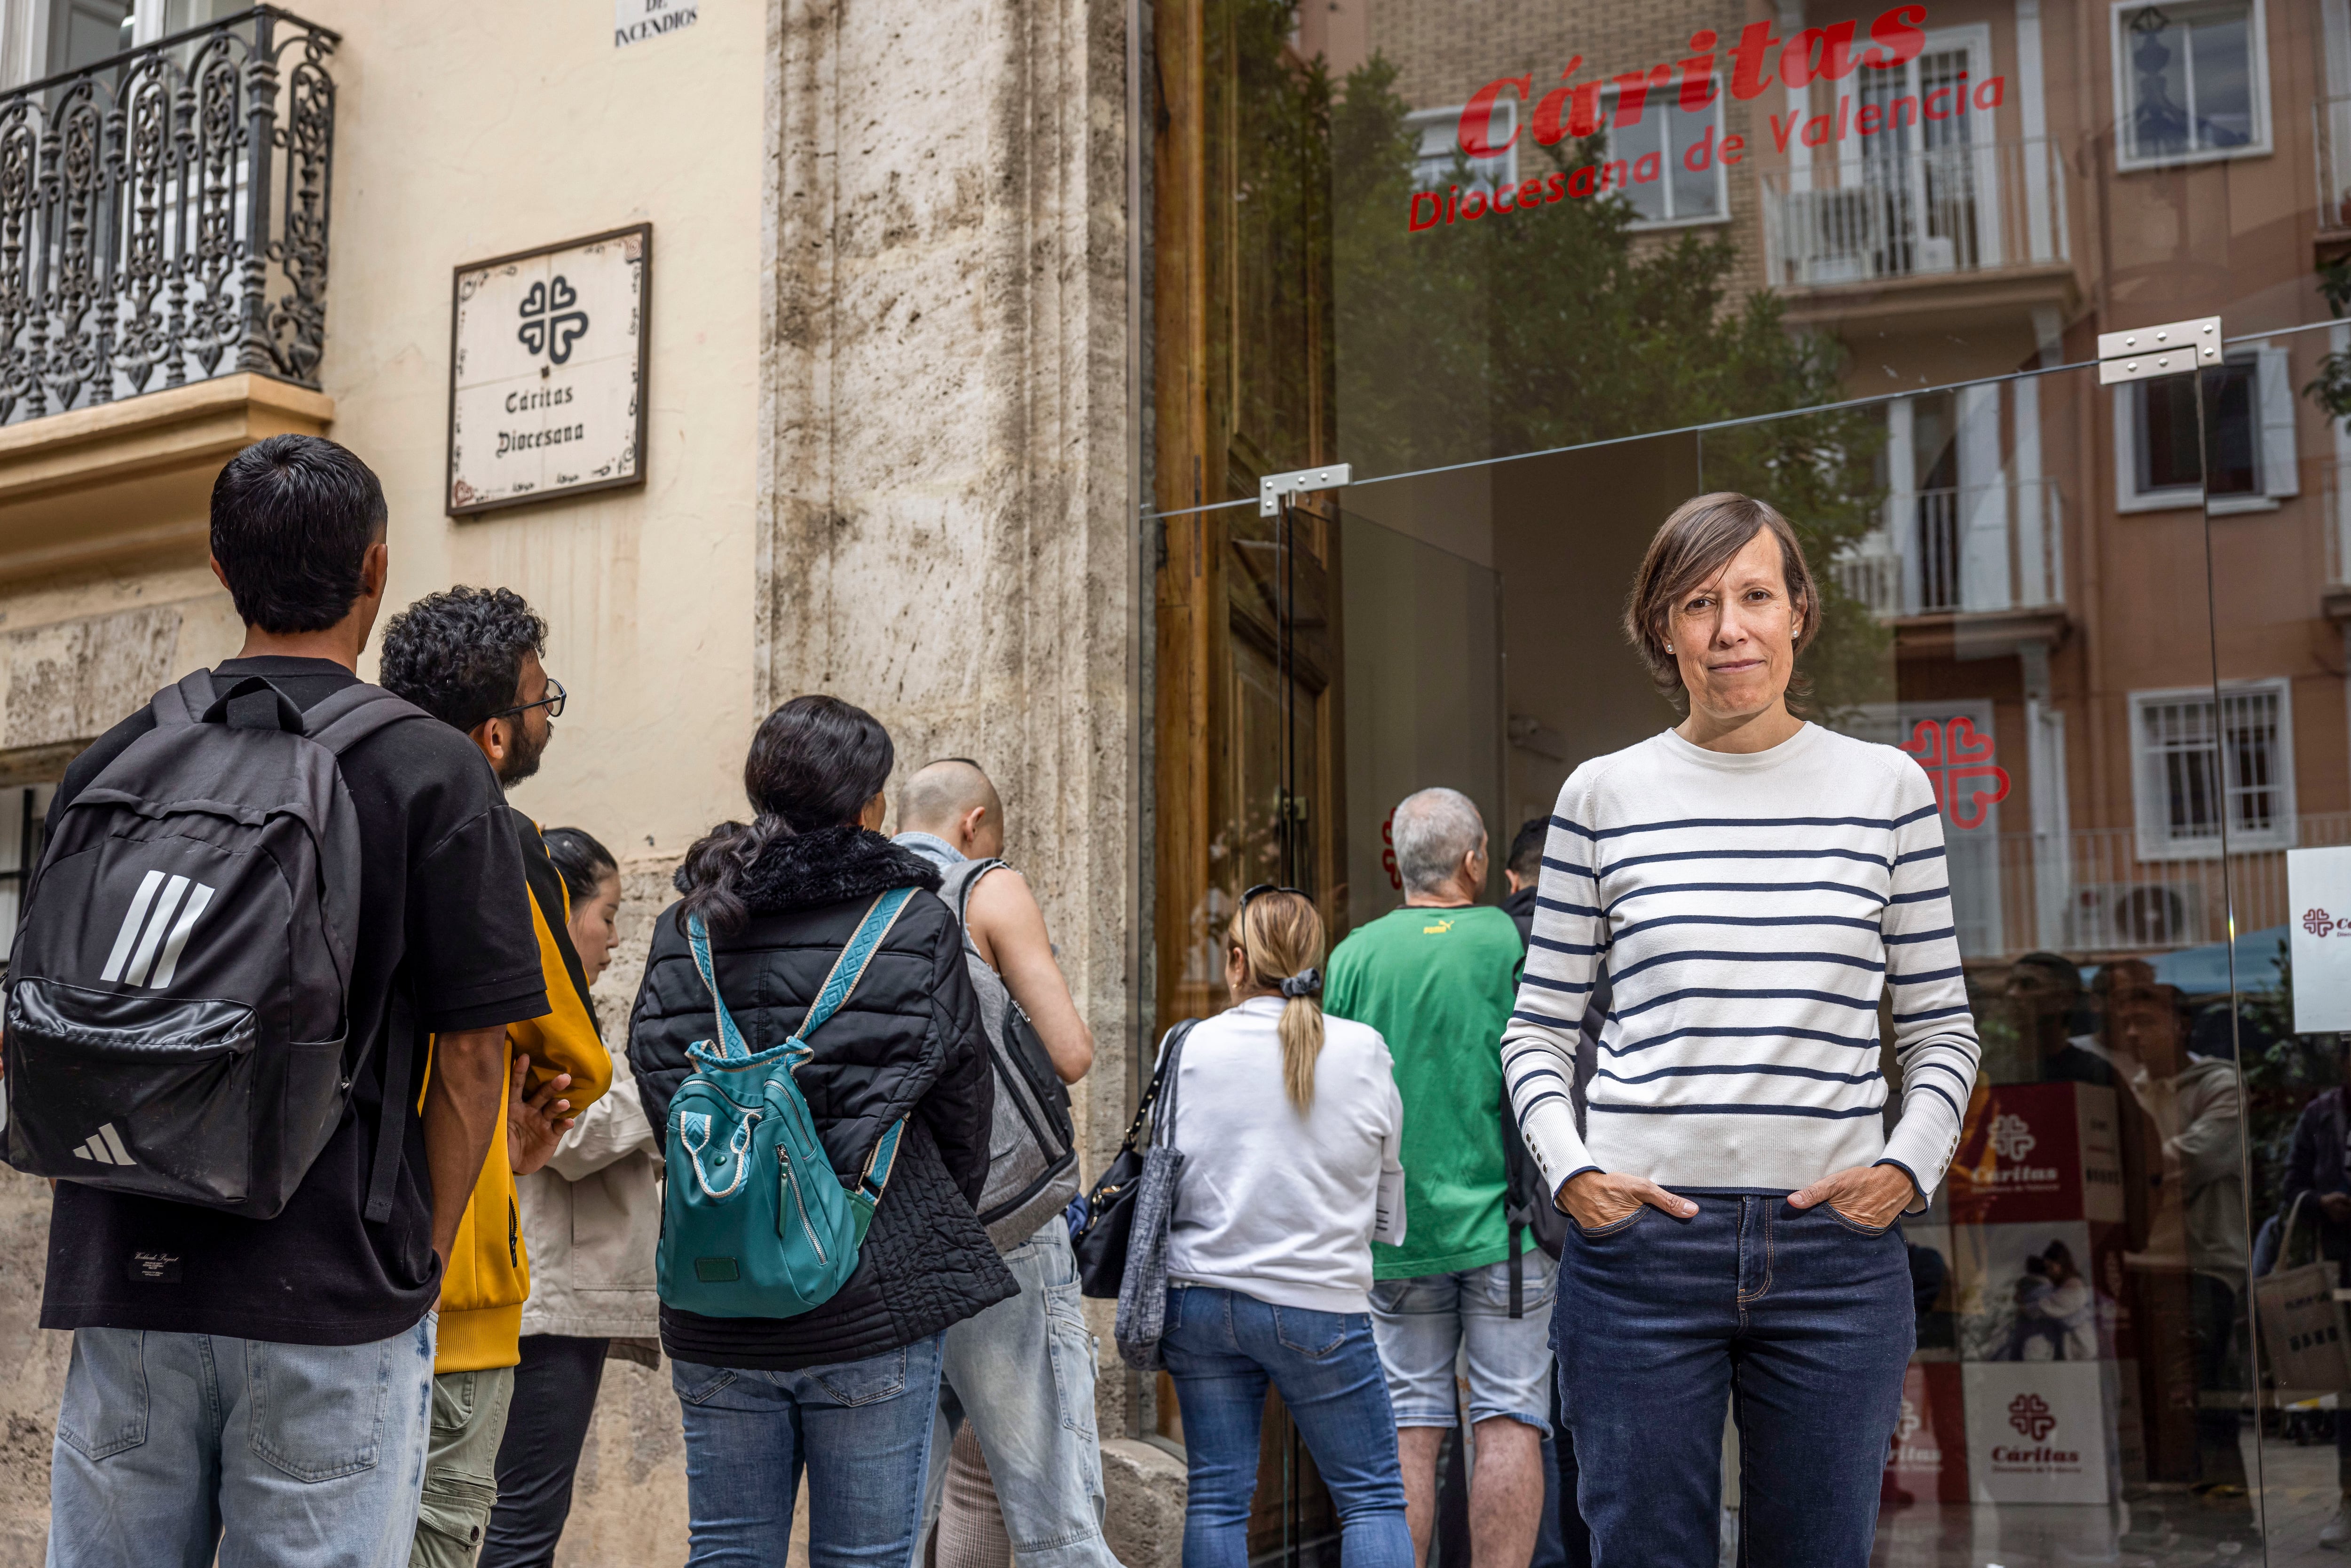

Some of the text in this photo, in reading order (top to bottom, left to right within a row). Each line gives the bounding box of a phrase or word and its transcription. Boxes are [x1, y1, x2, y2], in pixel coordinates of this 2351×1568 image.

[615, 8, 697, 47] INCENDIOS
[1458, 4, 1927, 158] Cáritas
[1409, 71, 2005, 233] Diocesana de Valencia
[505, 386, 573, 414] Cáritas
[496, 423, 584, 458] Diocesana
